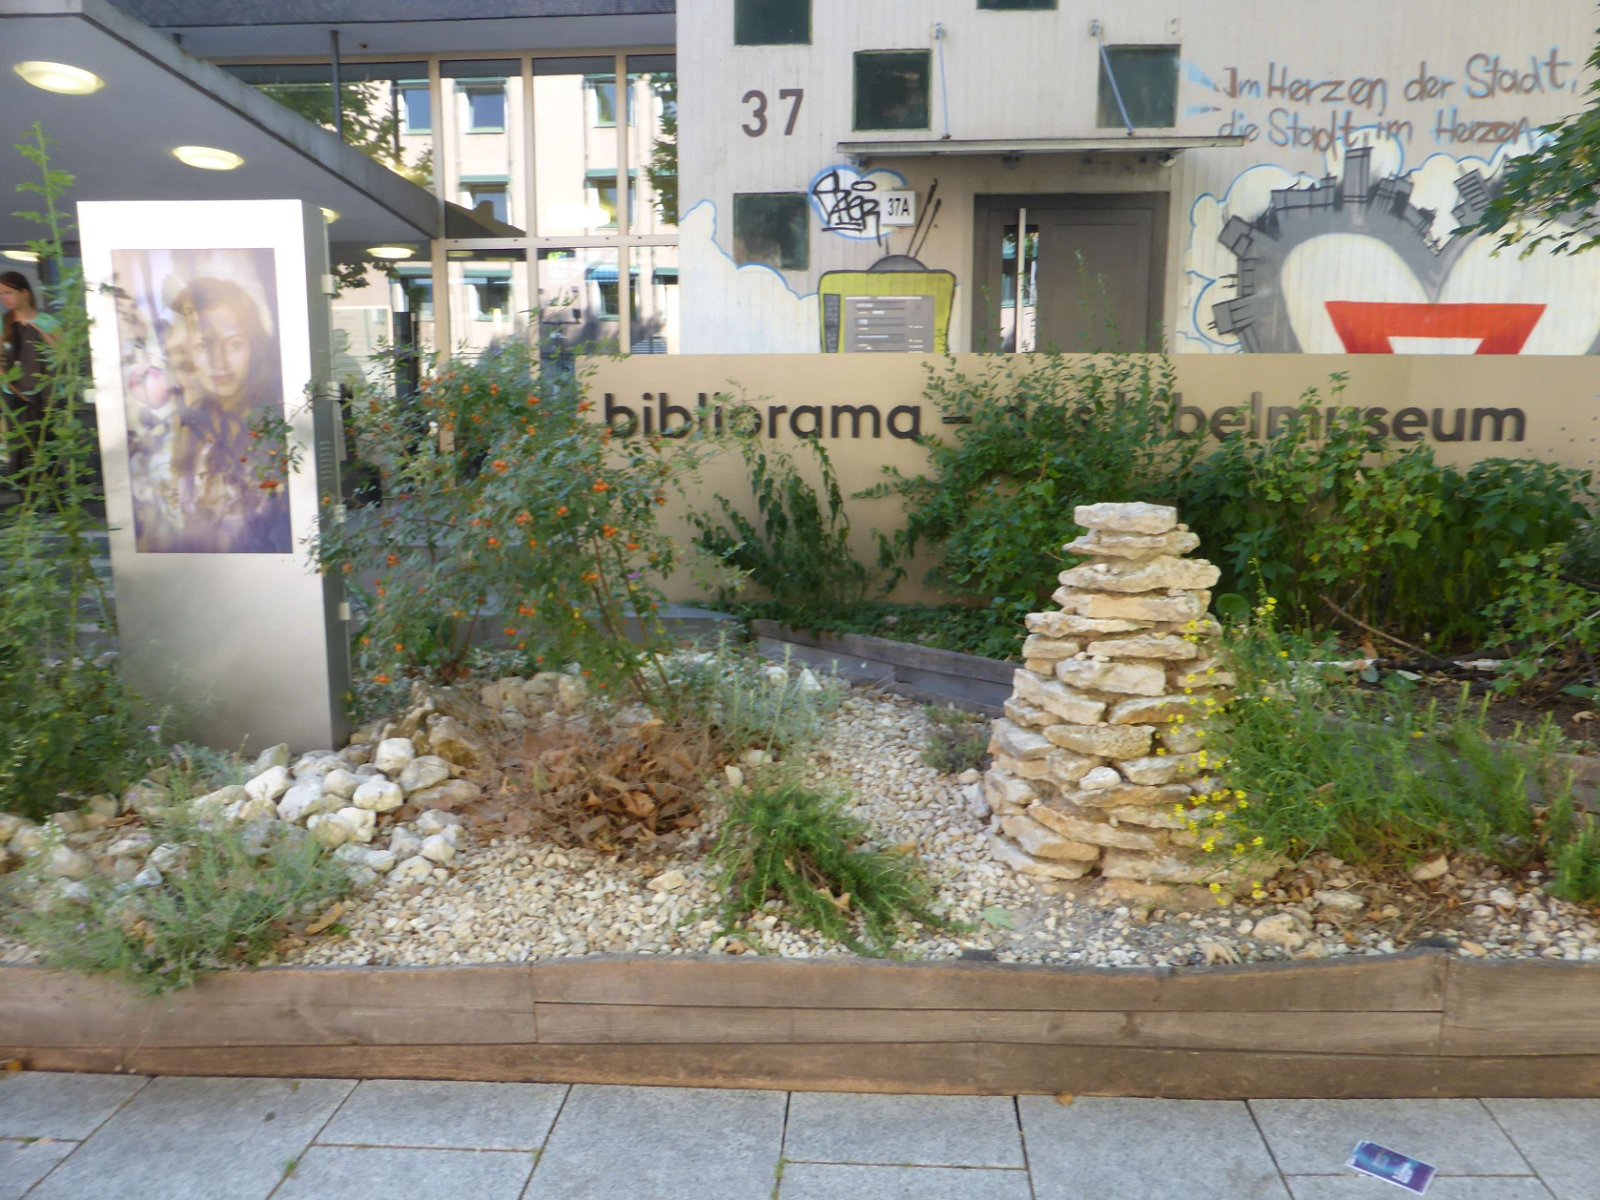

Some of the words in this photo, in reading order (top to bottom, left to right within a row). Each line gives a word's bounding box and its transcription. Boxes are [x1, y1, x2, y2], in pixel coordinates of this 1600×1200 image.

[1266, 62, 1387, 110] Herzen
[1403, 60, 1456, 102] der
[741, 88, 803, 137] 37
[1218, 109, 1259, 142] die
[1267, 107, 1359, 160] Stadt
[1376, 111, 1413, 145] im
[1433, 107, 1534, 150] Herzen
[887, 197, 910, 217] 37A
[604, 391, 920, 438] bibliorama
[1116, 392, 1526, 442] ibelmseum
